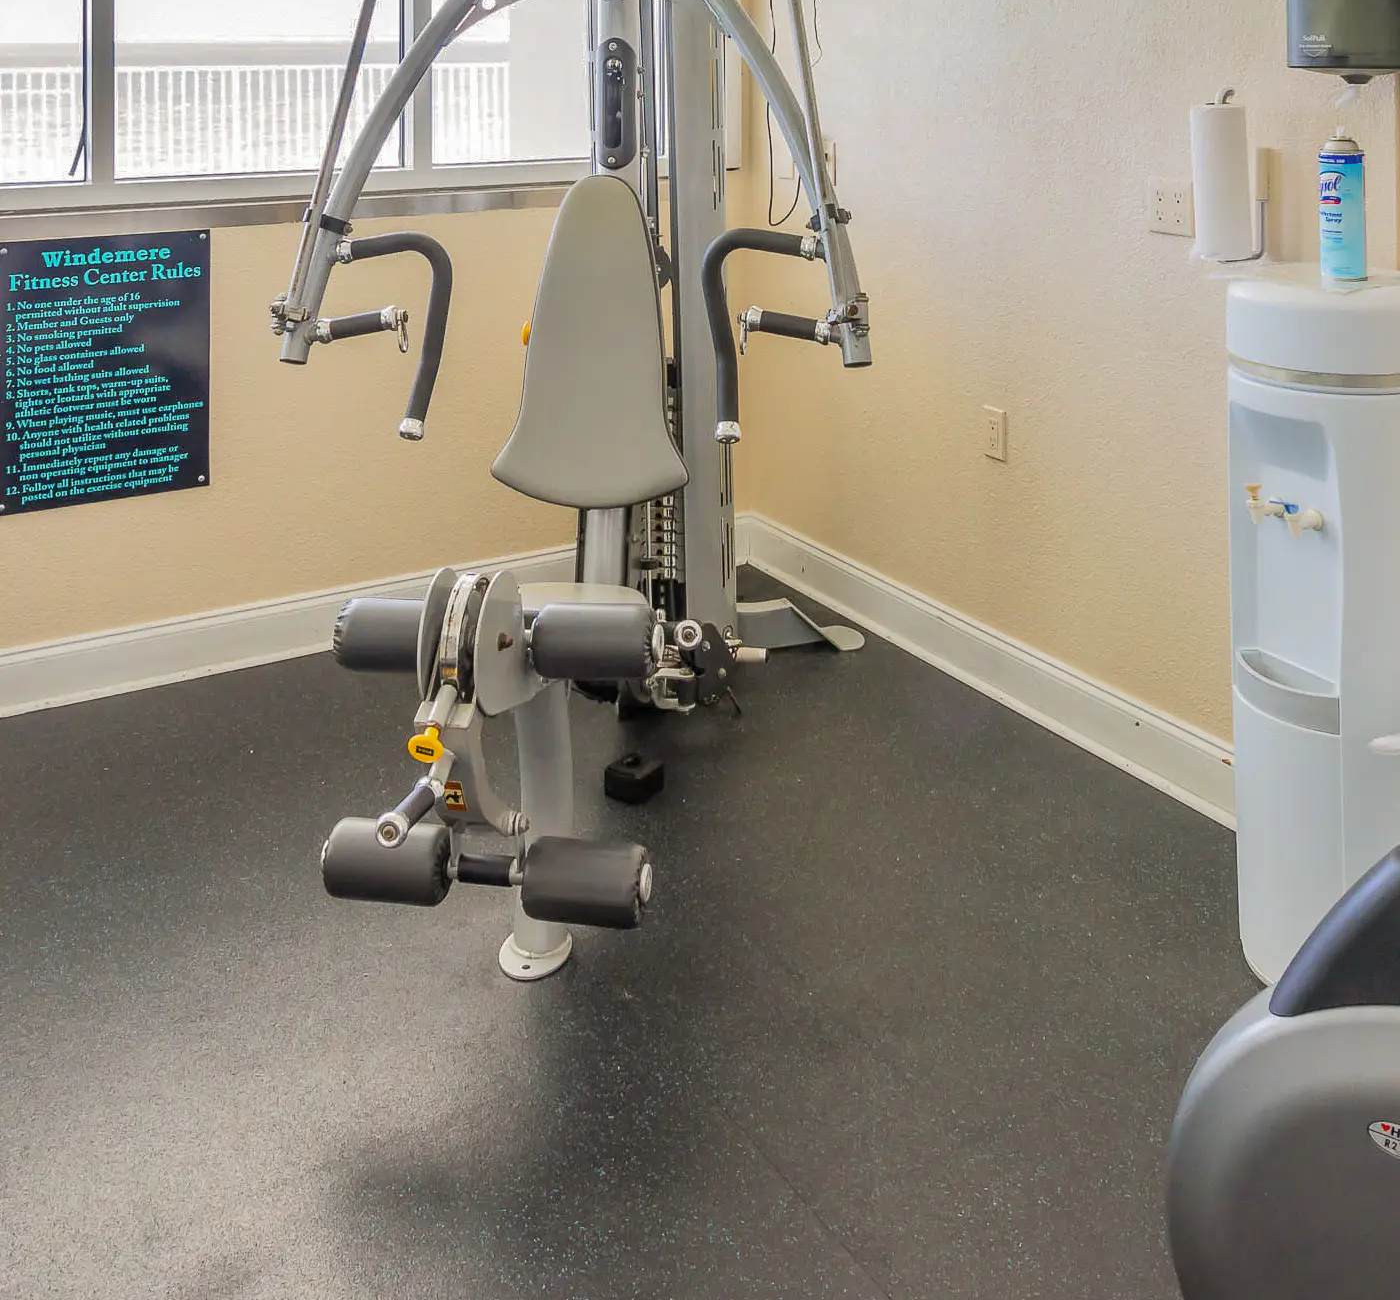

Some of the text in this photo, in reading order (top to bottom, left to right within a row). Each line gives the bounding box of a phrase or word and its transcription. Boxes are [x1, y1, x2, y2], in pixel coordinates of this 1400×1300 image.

[41, 247, 171, 268] Windemere
[8, 261, 201, 292] Fitness Center Rules
[6, 292, 141, 312] 1. No one under the age of 16
[15, 298, 180, 322] permitted without adult supervision
[6, 312, 135, 332] 2. Member and Guests only
[6, 324, 123, 343] 3. No smoking permitted
[6, 337, 92, 354] 4. No pets allowed
[6, 343, 145, 366] 5. No glass containers allowed
[6, 359, 94, 377] 6. No food allowed
[6, 364, 150, 388] 7. No wet bathing suits allowed
[6, 375, 169, 400] 8. Shorts, tank tops, warm-up suits,
[15, 384, 171, 410] tights or leotards with appropriate
[6, 401, 204, 430] 9. When playing music, must use earphones
[15, 396, 157, 419] athletic footwear must be worn
[6, 412, 190, 442] 10. Anyone with health related problems
[19, 422, 189, 450] should not utilize without consulting
[6, 445, 179, 474] 11. Immediately report any damage or
[19, 442, 106, 462] personal physician
[19, 452, 189, 481] non operating equipment to manager
[6, 464, 179, 496] 12. Follow all instructions that may be
[22, 474, 173, 505] posted on the exercise equipment
